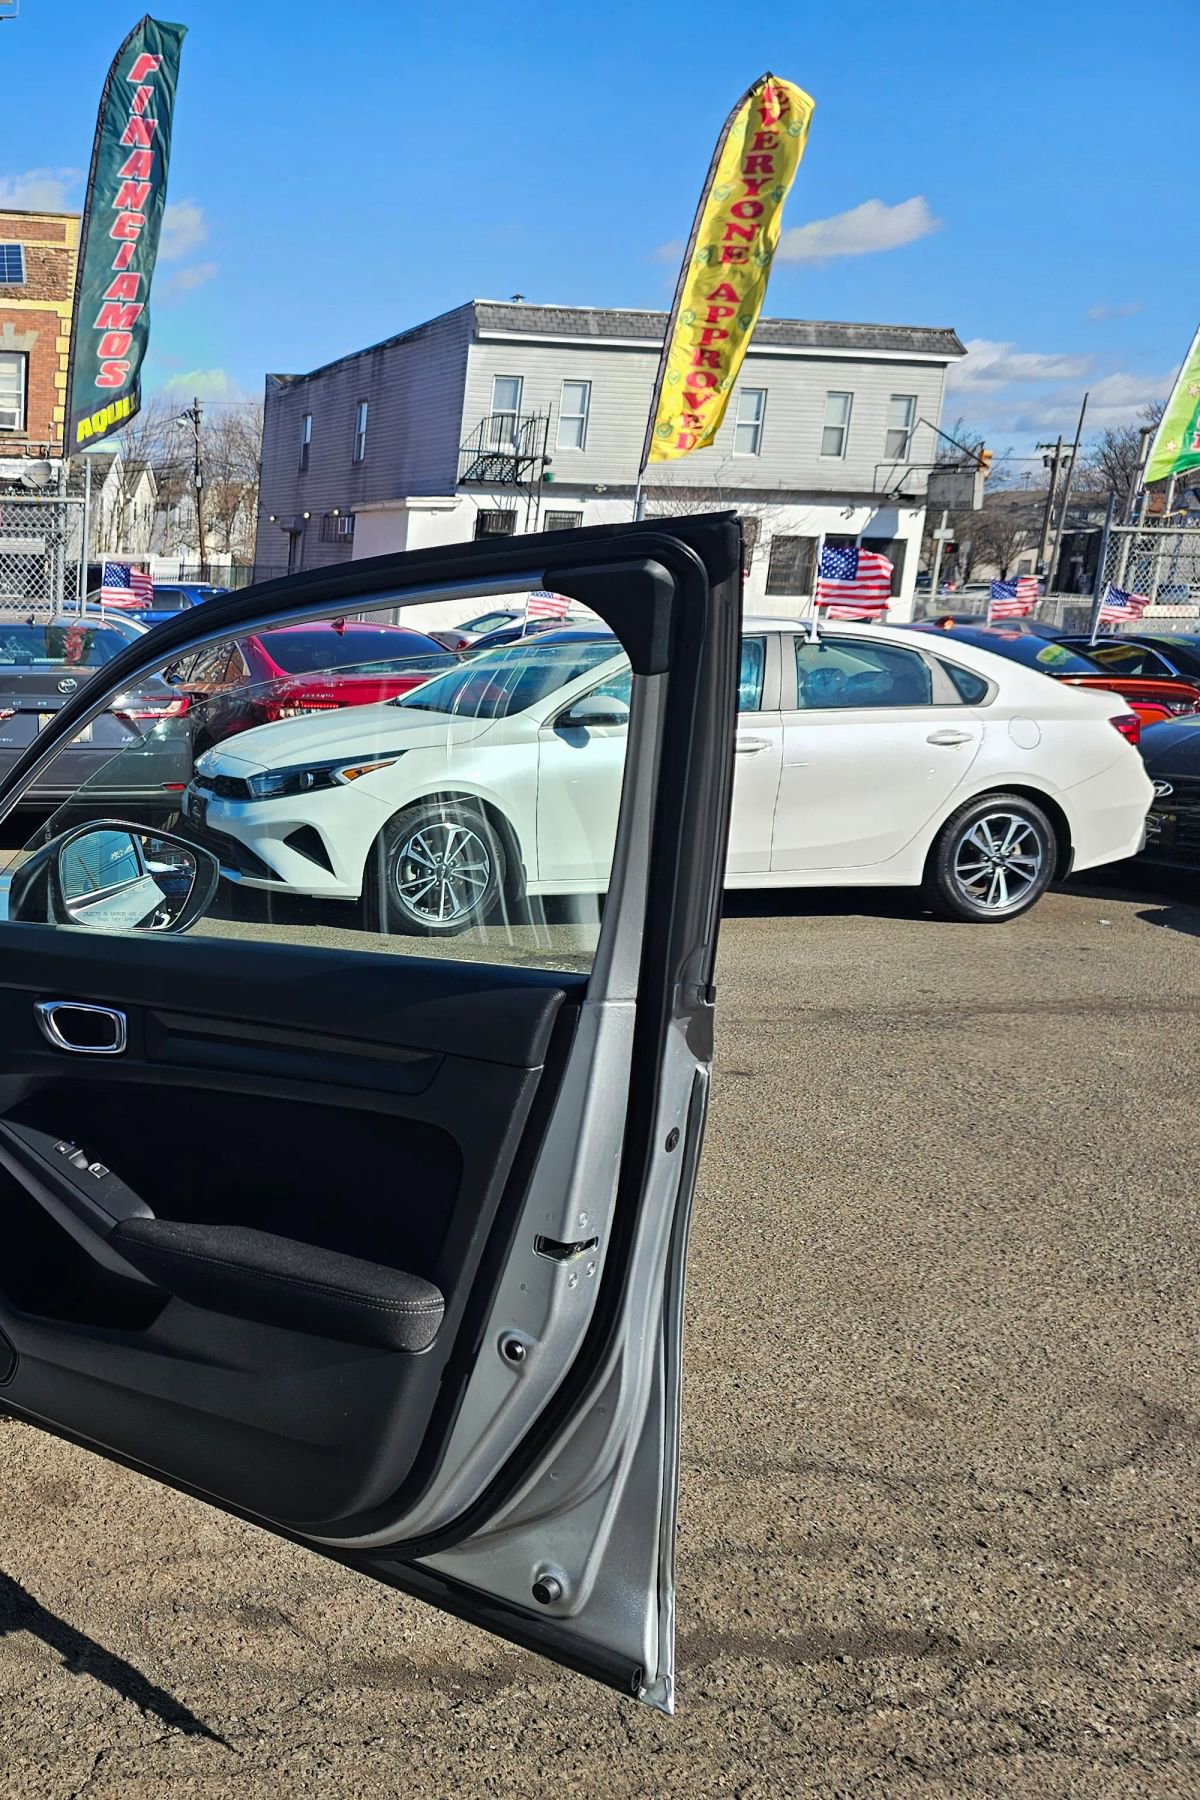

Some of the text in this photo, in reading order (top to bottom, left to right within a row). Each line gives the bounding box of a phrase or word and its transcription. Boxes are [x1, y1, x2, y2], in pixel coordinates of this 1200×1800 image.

[93, 52, 163, 388] FINANCIAMOS
[718, 83, 791, 265] EVERYONE
[676, 282, 741, 450] APPROVED
